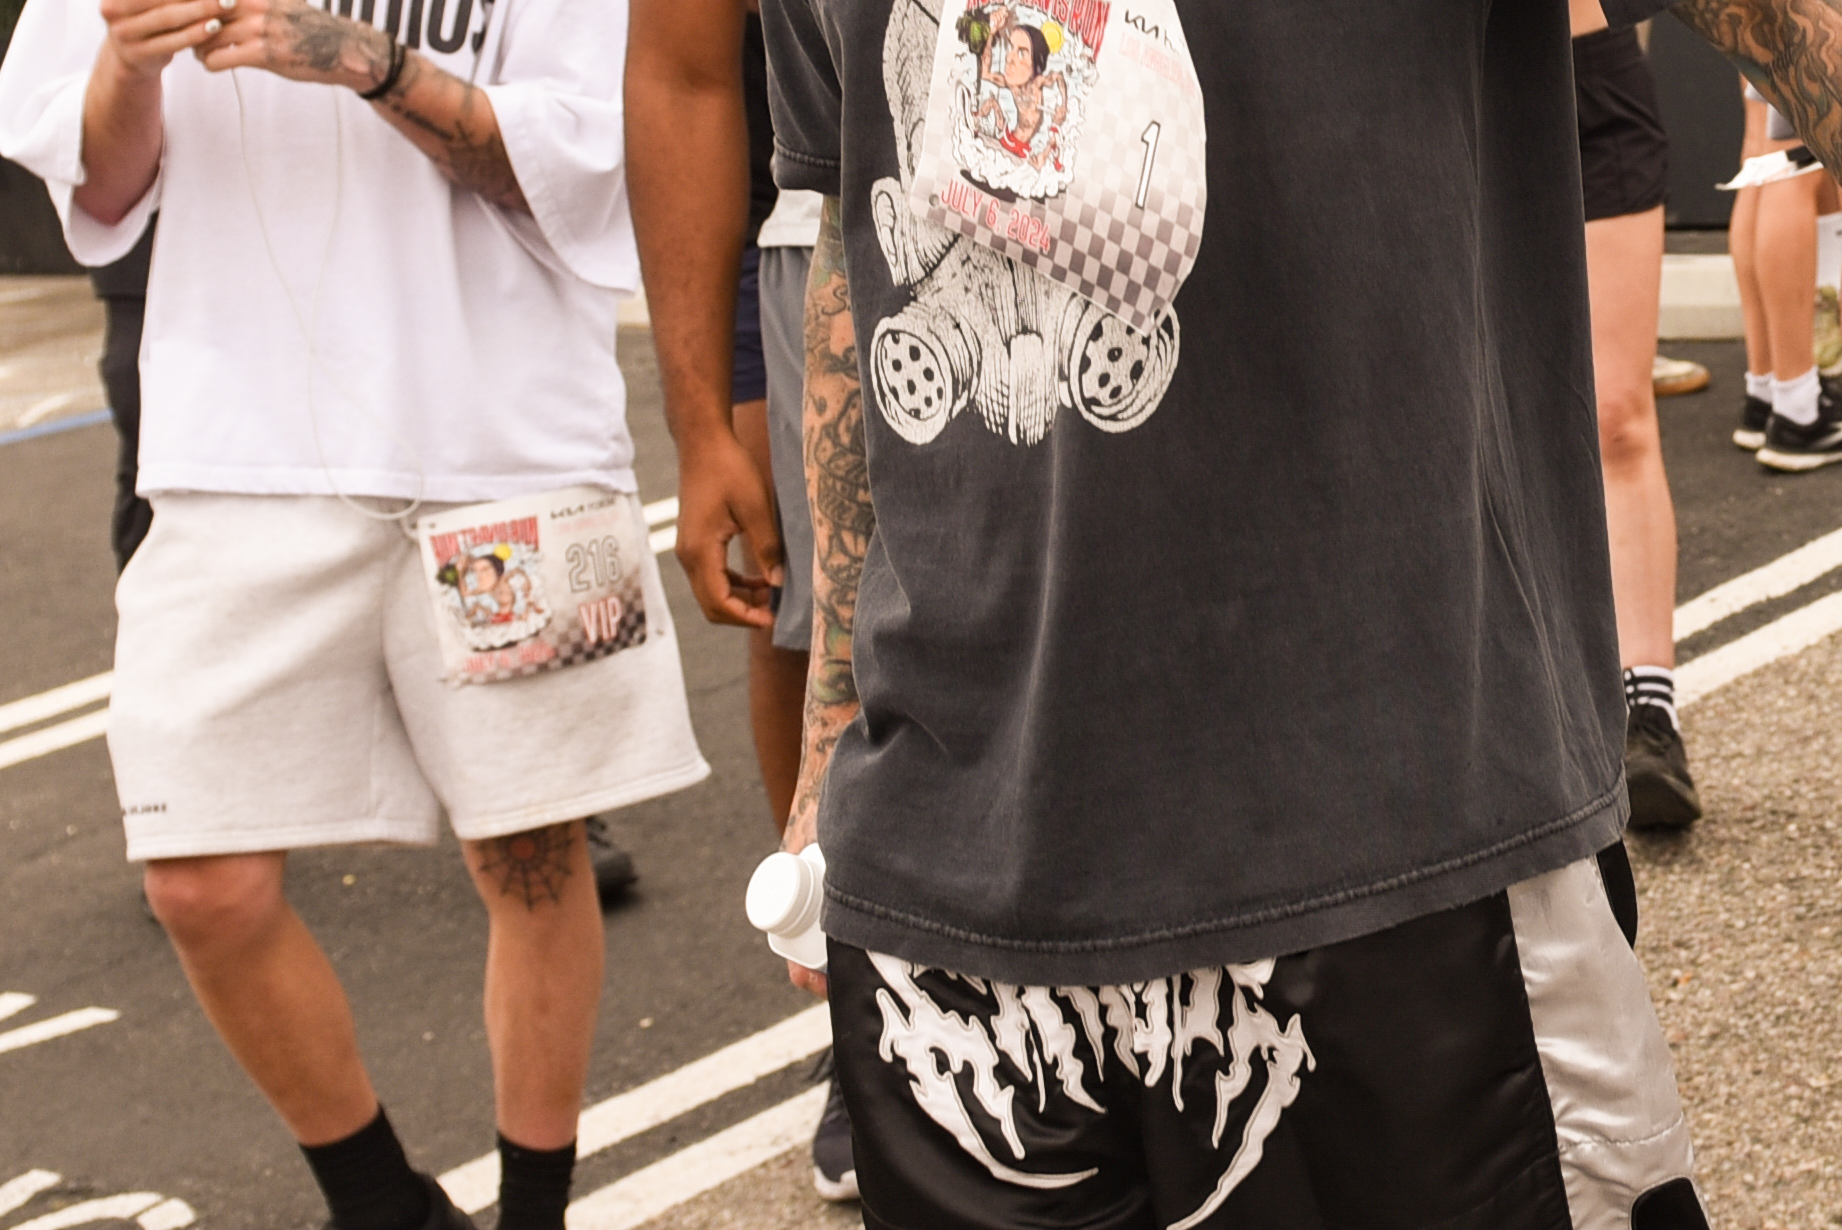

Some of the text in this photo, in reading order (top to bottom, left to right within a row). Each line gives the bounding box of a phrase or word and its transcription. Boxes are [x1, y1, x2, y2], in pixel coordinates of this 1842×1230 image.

[1136, 120, 1162, 210] 1
[941, 178, 1051, 255] JULY 6, 2024
[565, 535, 622, 594] 216
[578, 595, 623, 644] VIP
